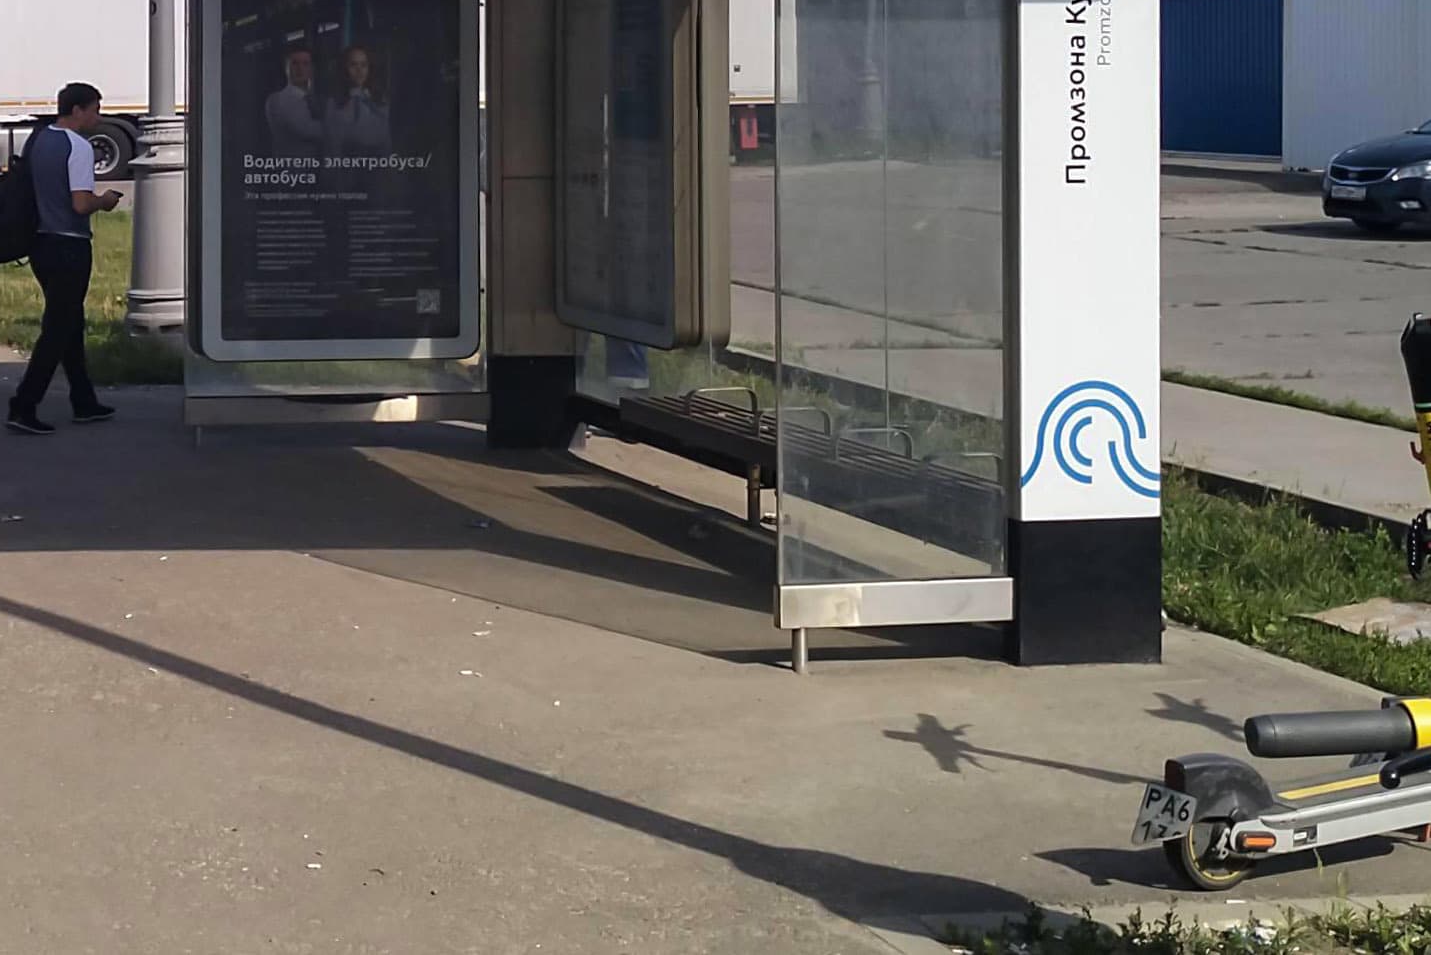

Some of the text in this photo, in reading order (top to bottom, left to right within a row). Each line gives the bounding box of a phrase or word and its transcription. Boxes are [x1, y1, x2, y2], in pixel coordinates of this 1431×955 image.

[1066, 35, 1092, 184] Промзона
[243, 152, 432, 171] Водитель электробуса/
[244, 170, 317, 187] автобуса
